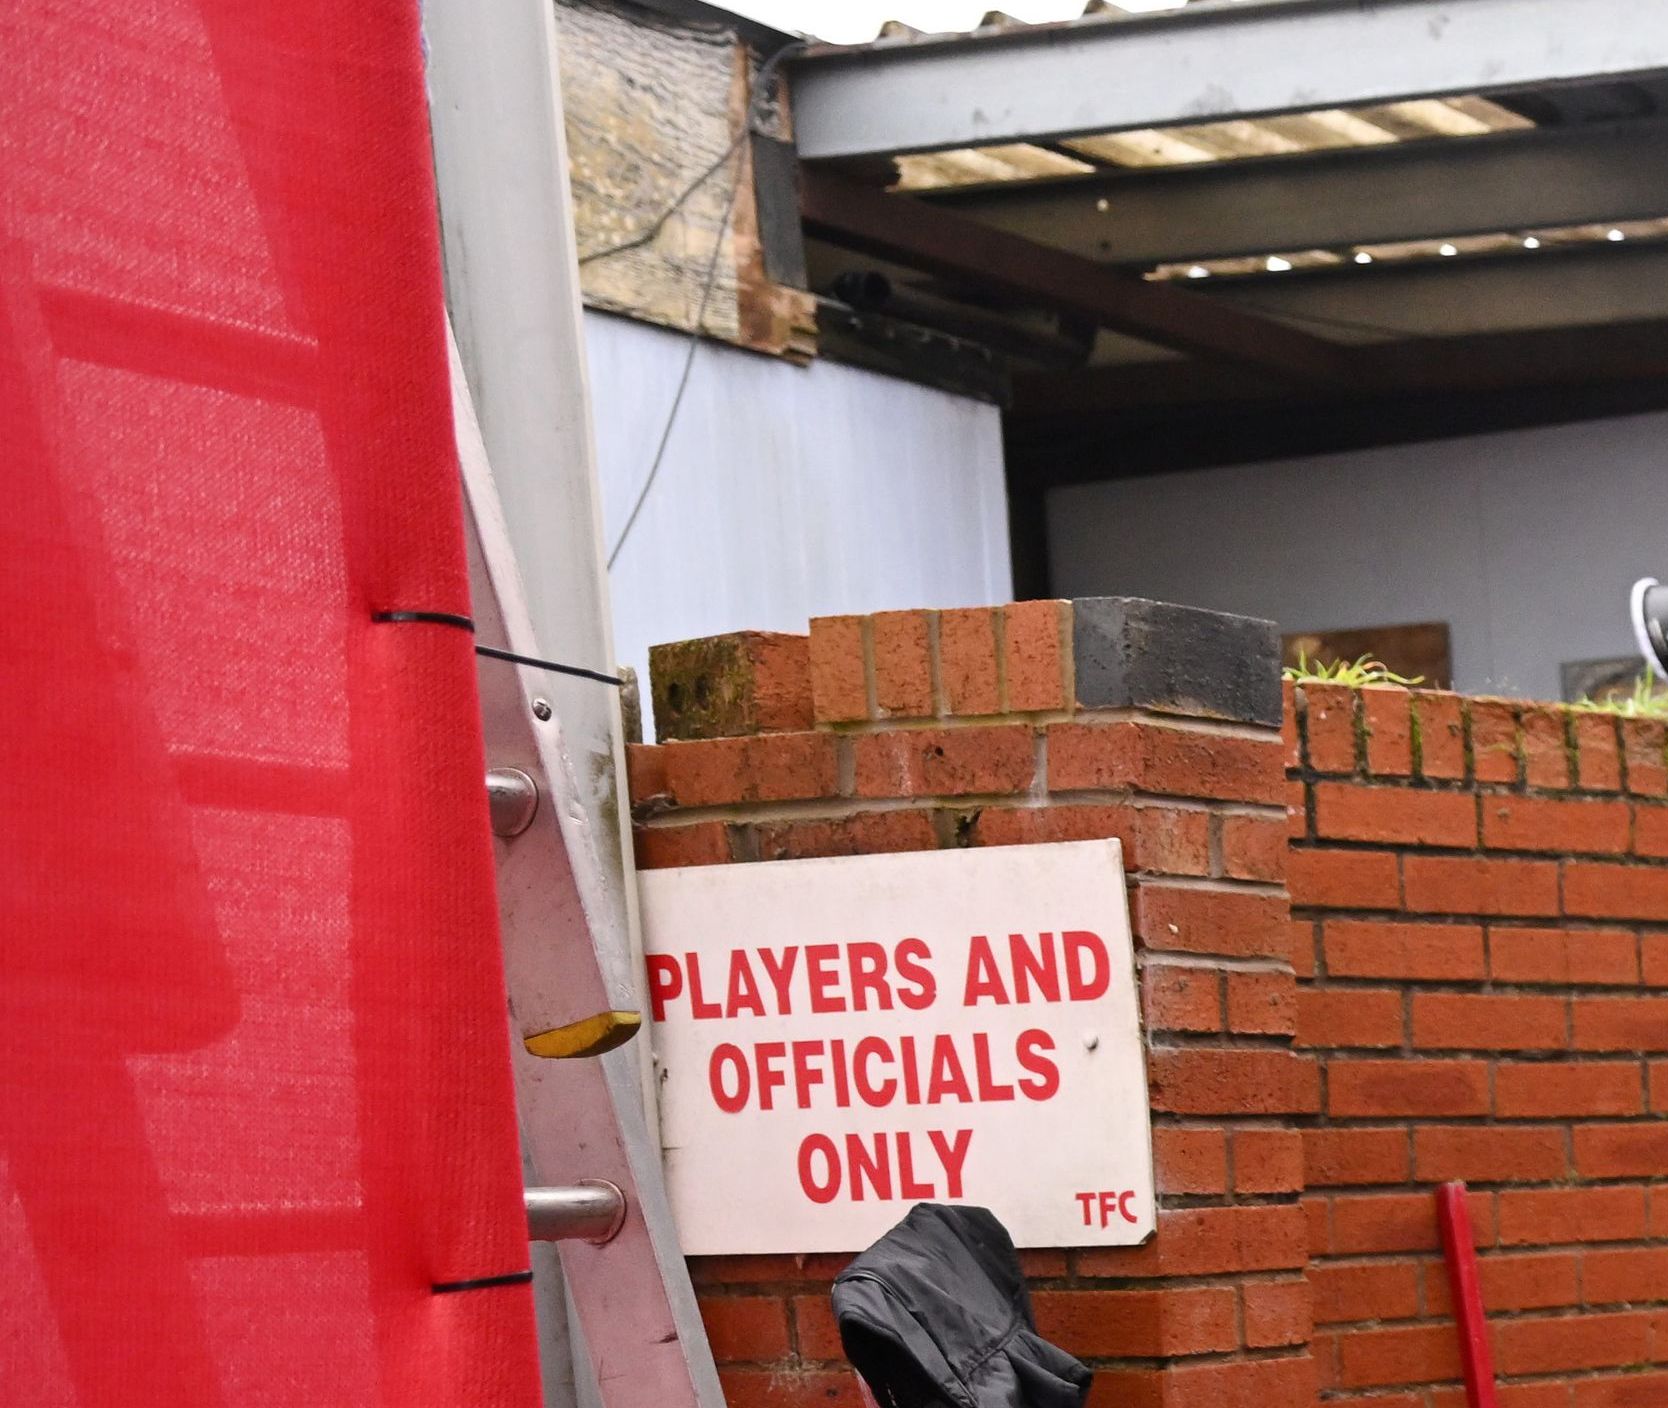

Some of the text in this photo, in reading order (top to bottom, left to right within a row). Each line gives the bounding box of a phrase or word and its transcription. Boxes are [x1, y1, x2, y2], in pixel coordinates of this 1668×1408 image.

[646, 930, 1110, 1021] PLAYERS AND
[709, 1029, 1059, 1113] OFFICIALS
[798, 1129, 973, 1204] ONLY
[1075, 1189, 1138, 1229] TFC
